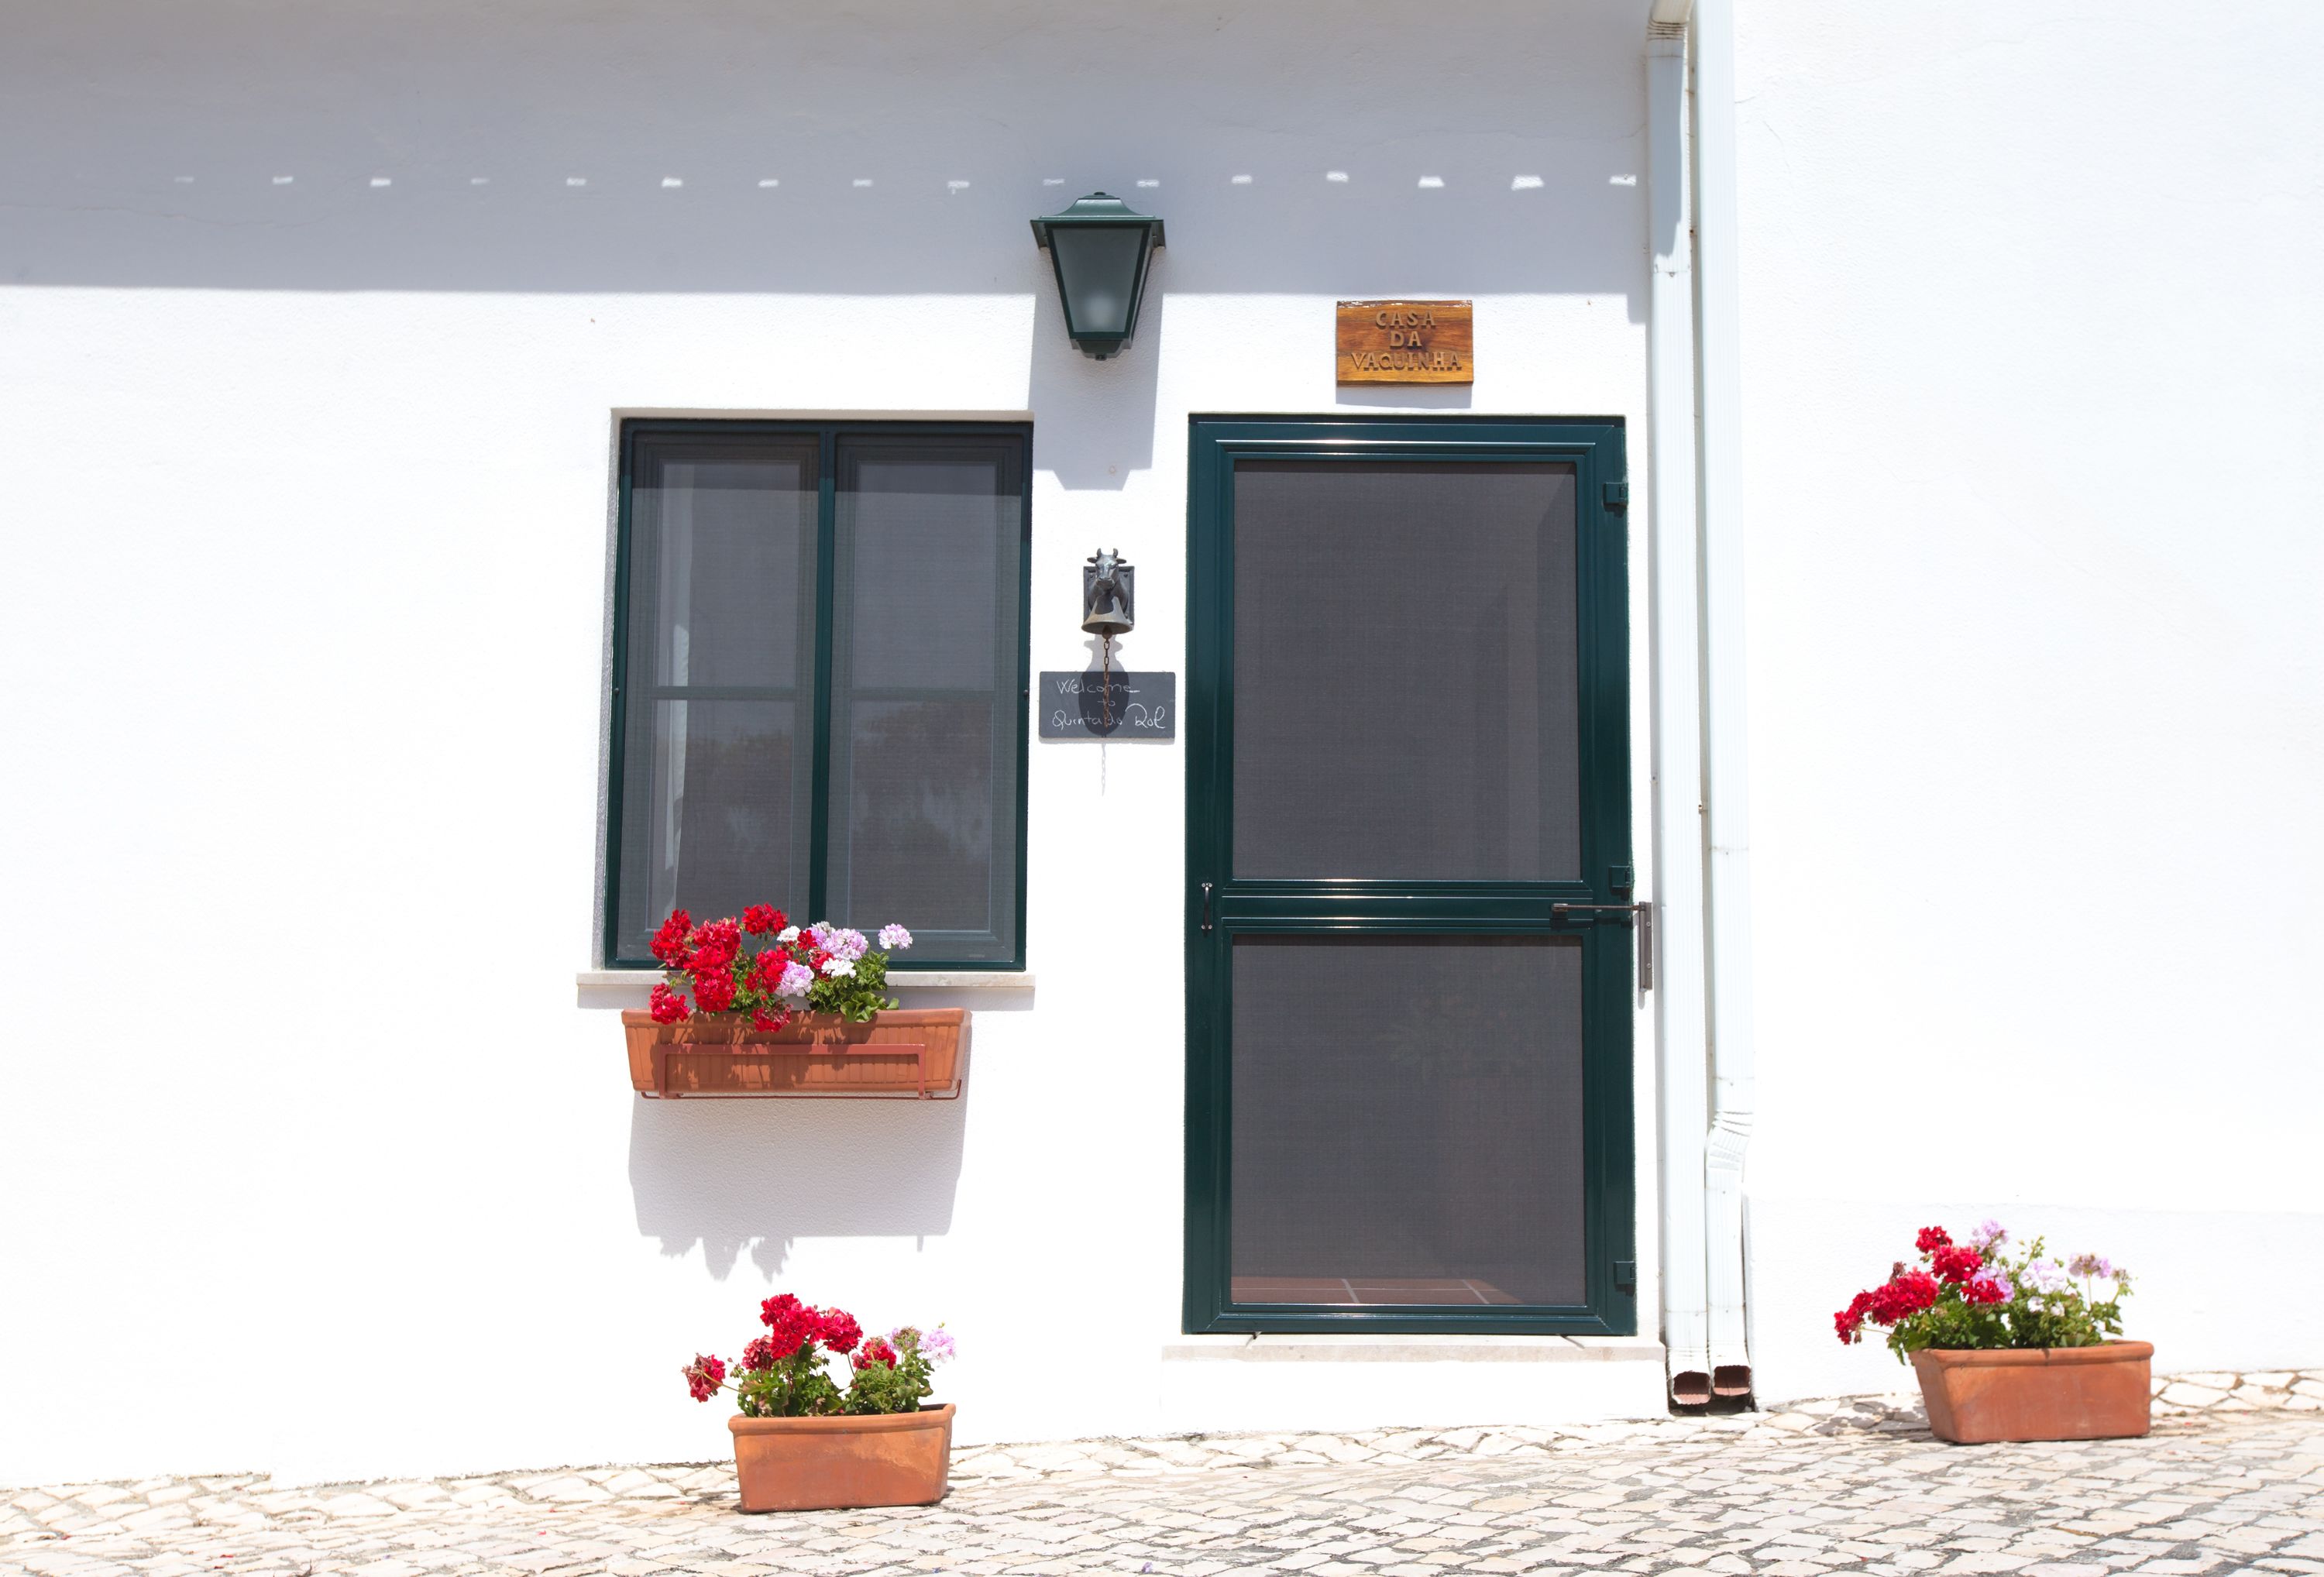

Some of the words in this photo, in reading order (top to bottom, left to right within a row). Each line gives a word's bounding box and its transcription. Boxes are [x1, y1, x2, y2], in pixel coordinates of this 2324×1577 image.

[1376, 310, 1435, 328] CASA
[1389, 330, 1422, 349] DA
[1350, 352, 1462, 370] VAQUINHA
[1057, 679, 1140, 694] Welcome
[1052, 709, 1101, 730] Quinta
